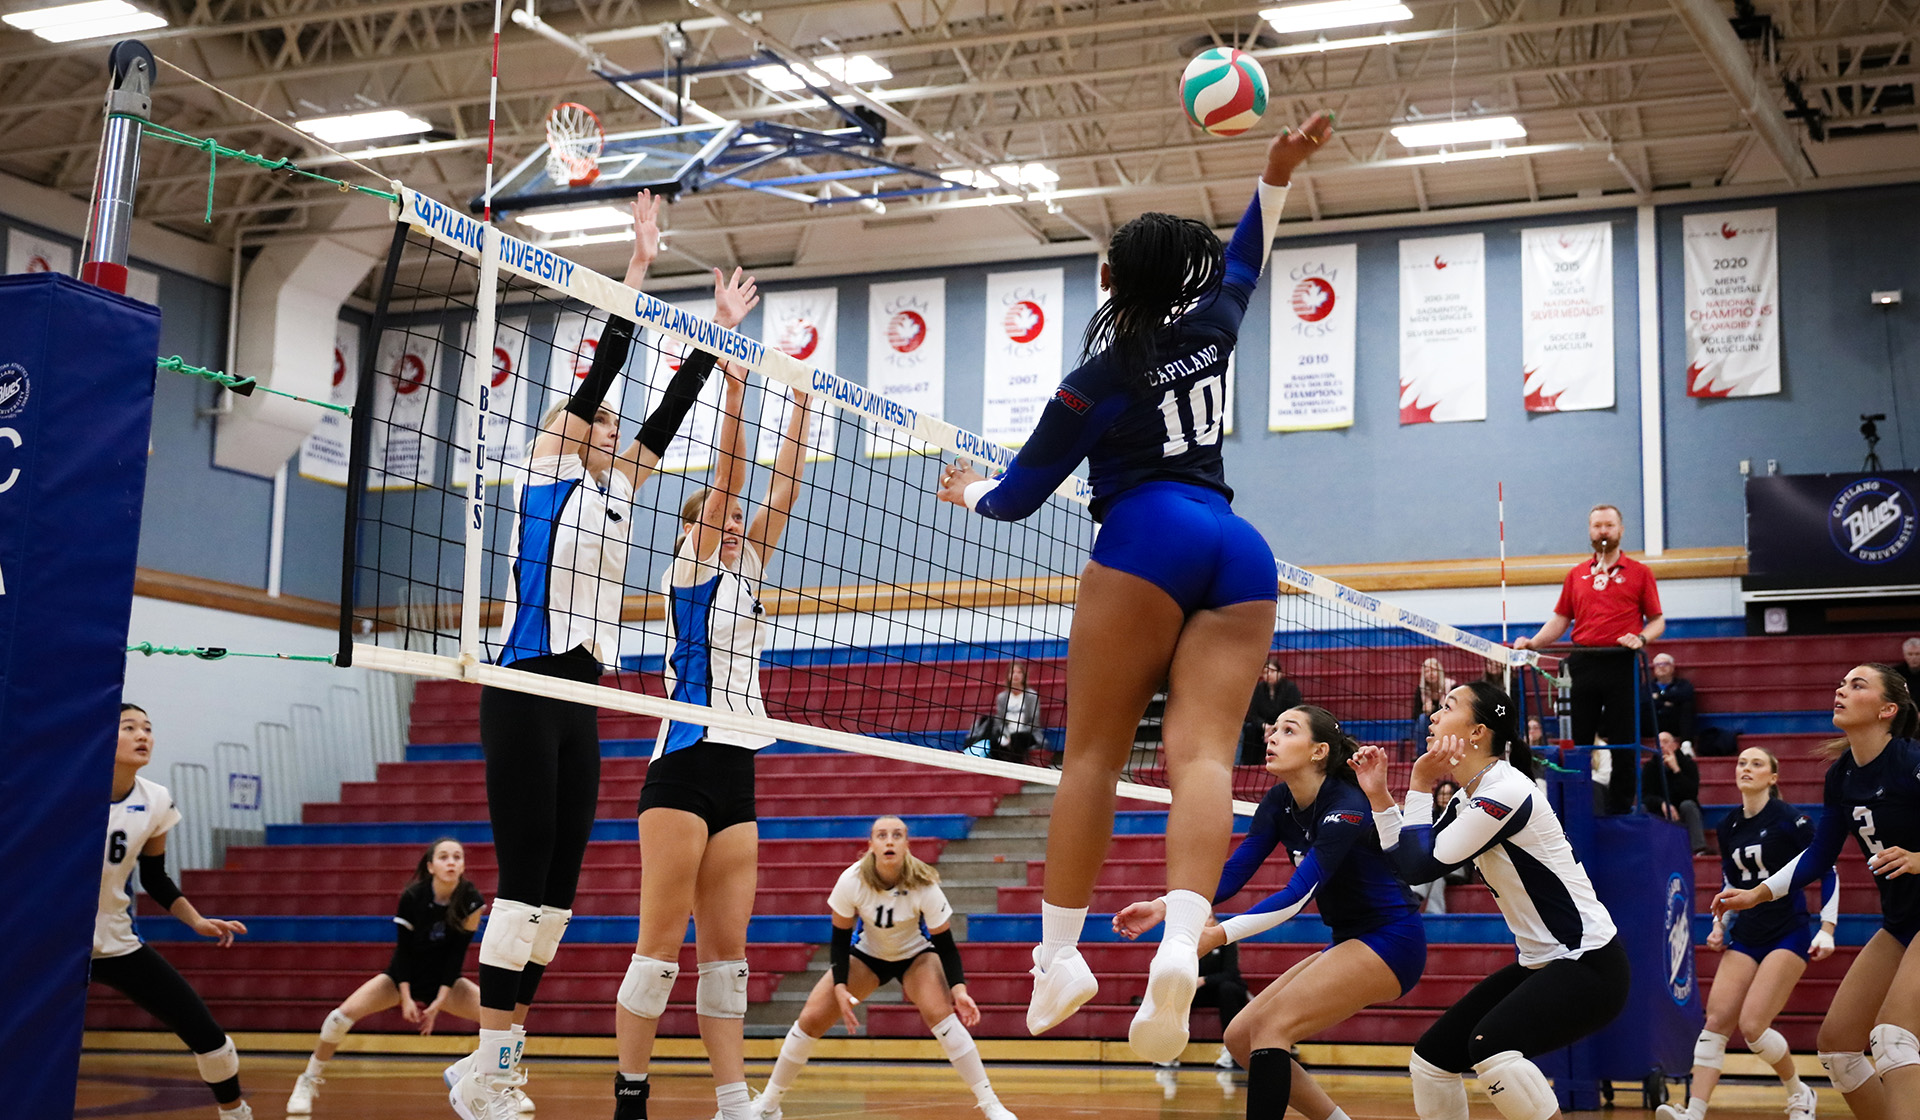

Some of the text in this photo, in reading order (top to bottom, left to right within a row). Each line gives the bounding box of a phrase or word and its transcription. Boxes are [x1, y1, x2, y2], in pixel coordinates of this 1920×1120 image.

[499, 236, 575, 287] NIVERSITY
[1554, 261, 1580, 272] 2015
[1713, 257, 1748, 270] 2020
[1700, 284, 1762, 296] VOLLEYBALL
[1705, 298, 1756, 309] NATIONAL
[635, 292, 765, 367] CAPILANO UNIVERSITY
[1543, 341, 1593, 352] MASCULIN
[1549, 332, 1587, 342] SOCCER
[1701, 334, 1764, 345] VOLLEYBALL
[1144, 344, 1218, 387] CAPILANO
[1299, 353, 1329, 366] 2010
[1705, 343, 1760, 355] MASCULIN
[812, 368, 918, 430] CAPILANO UNIVERSITY
[1157, 374, 1223, 458] 10
[473, 384, 490, 530] BLUES
[956, 430, 998, 463] CAPILANO
[1832, 481, 1880, 518] CAPILANO
[1842, 490, 1902, 553] Blues
[1859, 515, 1914, 560] UNIVERSITY
[108, 829, 128, 866] 6
[1852, 806, 1885, 854] 2
[1732, 843, 1770, 881] 17
[874, 904, 895, 929] 11
